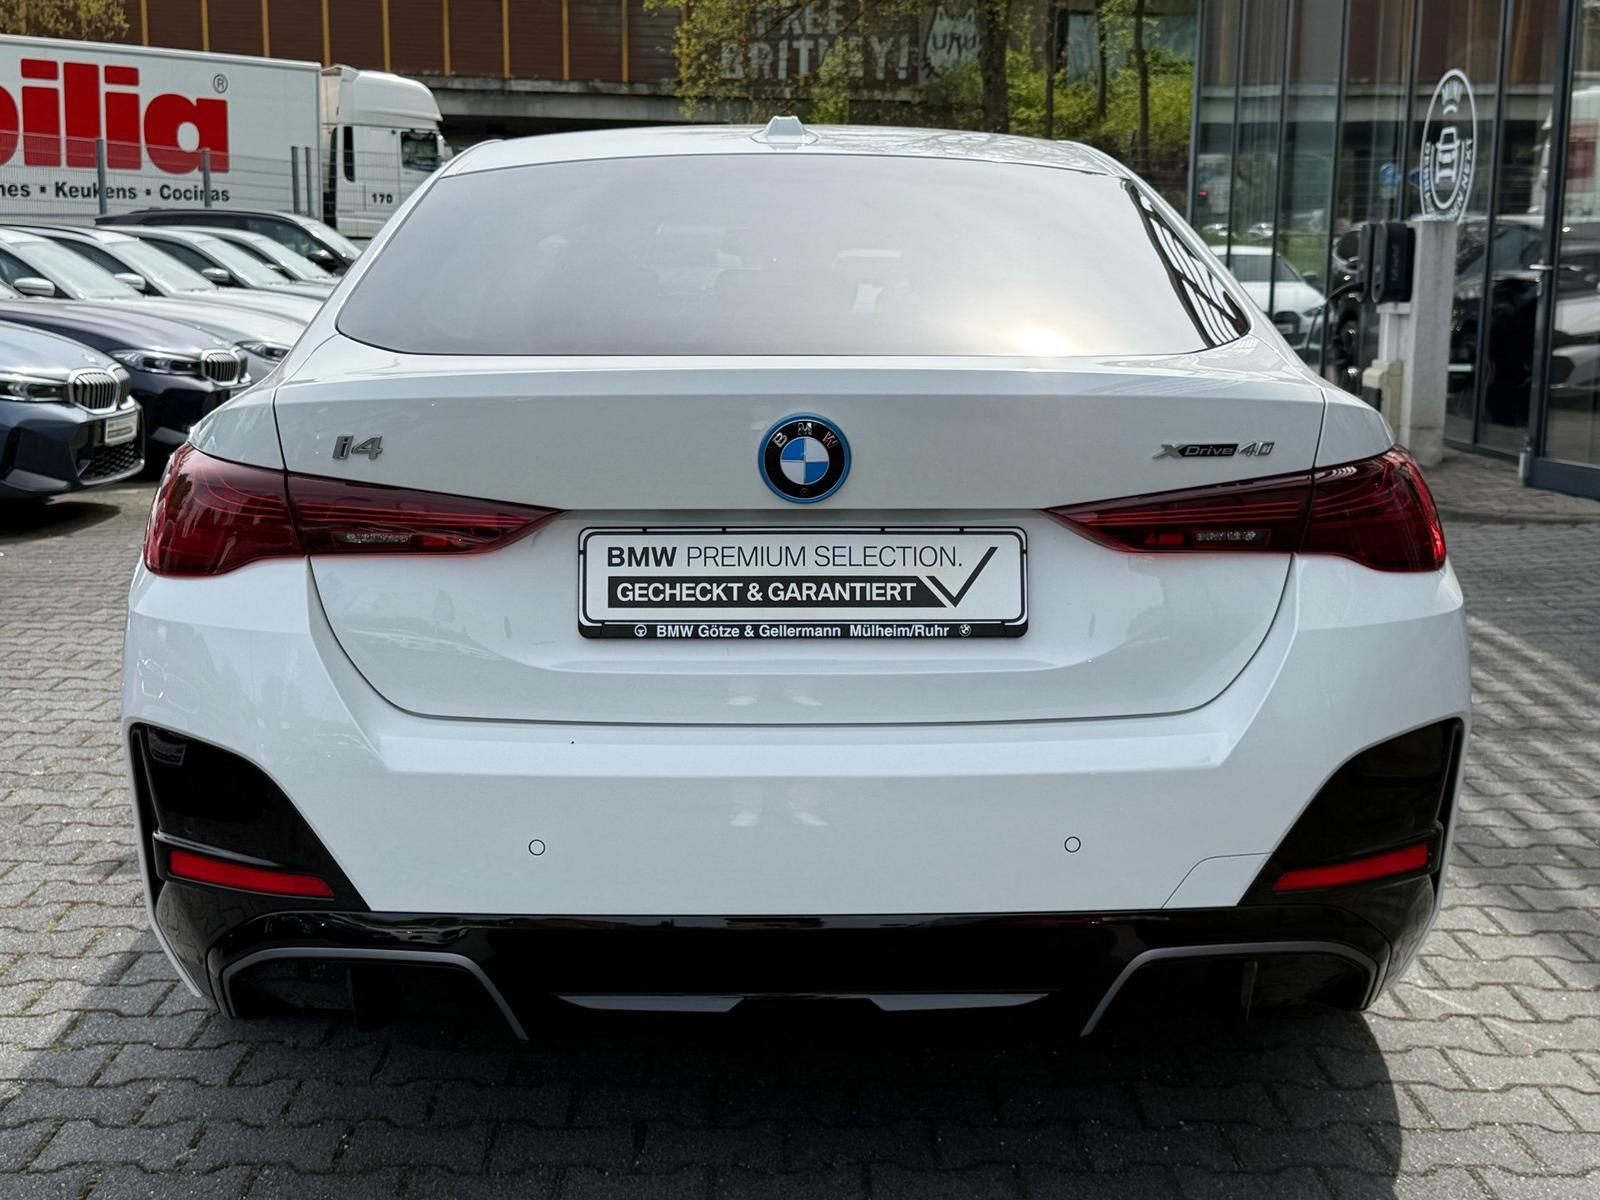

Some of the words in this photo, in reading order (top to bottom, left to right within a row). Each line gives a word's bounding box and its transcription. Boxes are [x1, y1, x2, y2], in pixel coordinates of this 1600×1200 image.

[0, 58, 229, 174] ilia
[55, 181, 137, 199] Keukens
[372, 193, 393, 204] 170
[772, 422, 838, 449] BMW
[332, 435, 383, 460] i4
[1237, 441, 1275, 457] 40
[607, 546, 677, 568] BMW
[686, 546, 806, 568] PREMIUM
[813, 546, 963, 568] SELECTION.
[616, 582, 742, 602] GECHECKT
[747, 582, 763, 602] &
[767, 582, 917, 602] GARANTIERT
[655, 624, 694, 638] BMW
[697, 623, 740, 638] Götze
[744, 624, 755, 638] &
[758, 624, 842, 638] Gellermann
[849, 623, 950, 639] Mülheim/Ruhr
